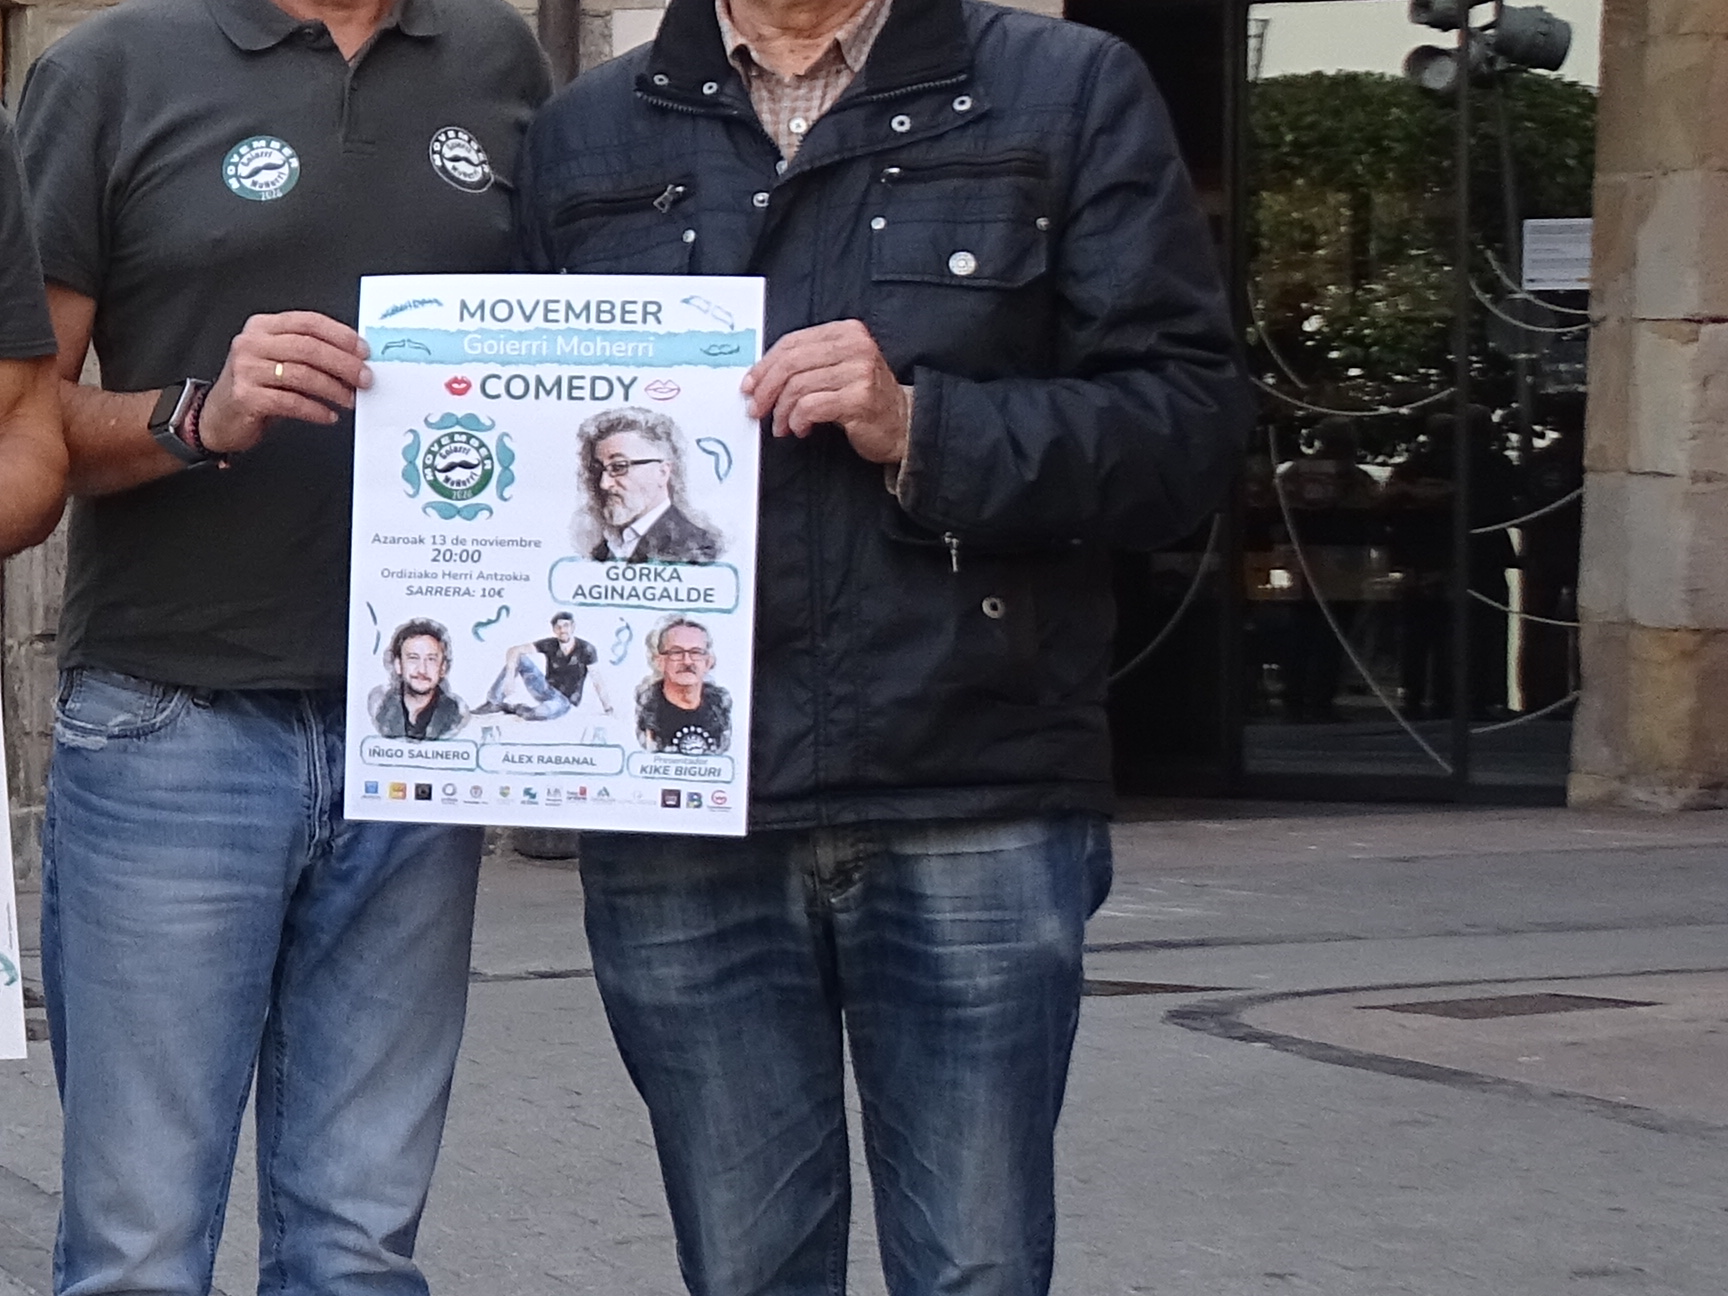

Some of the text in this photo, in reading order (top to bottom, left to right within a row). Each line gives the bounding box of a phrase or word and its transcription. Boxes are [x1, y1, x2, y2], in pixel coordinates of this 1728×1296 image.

[227, 140, 298, 189] MOVEMBER
[459, 299, 662, 325] MOVEMBER
[463, 334, 655, 357] Goierri Moherri
[480, 374, 638, 401] COMEDY
[424, 434, 491, 480] MOVEMBER
[372, 534, 542, 548] Azaroak 13 de noviembre
[431, 549, 482, 563] 20:00
[381, 569, 530, 581] Ordiziako Herri Antzokia
[606, 566, 683, 582] GORKA
[406, 585, 505, 598] SARRERA: 10€
[573, 585, 715, 602] AGINAGALDE
[368, 746, 470, 761] IÑIGO SALINERO
[502, 752, 597, 766] ÁLEX RABANAL
[640, 765, 721, 777] KIKE BIGURI
